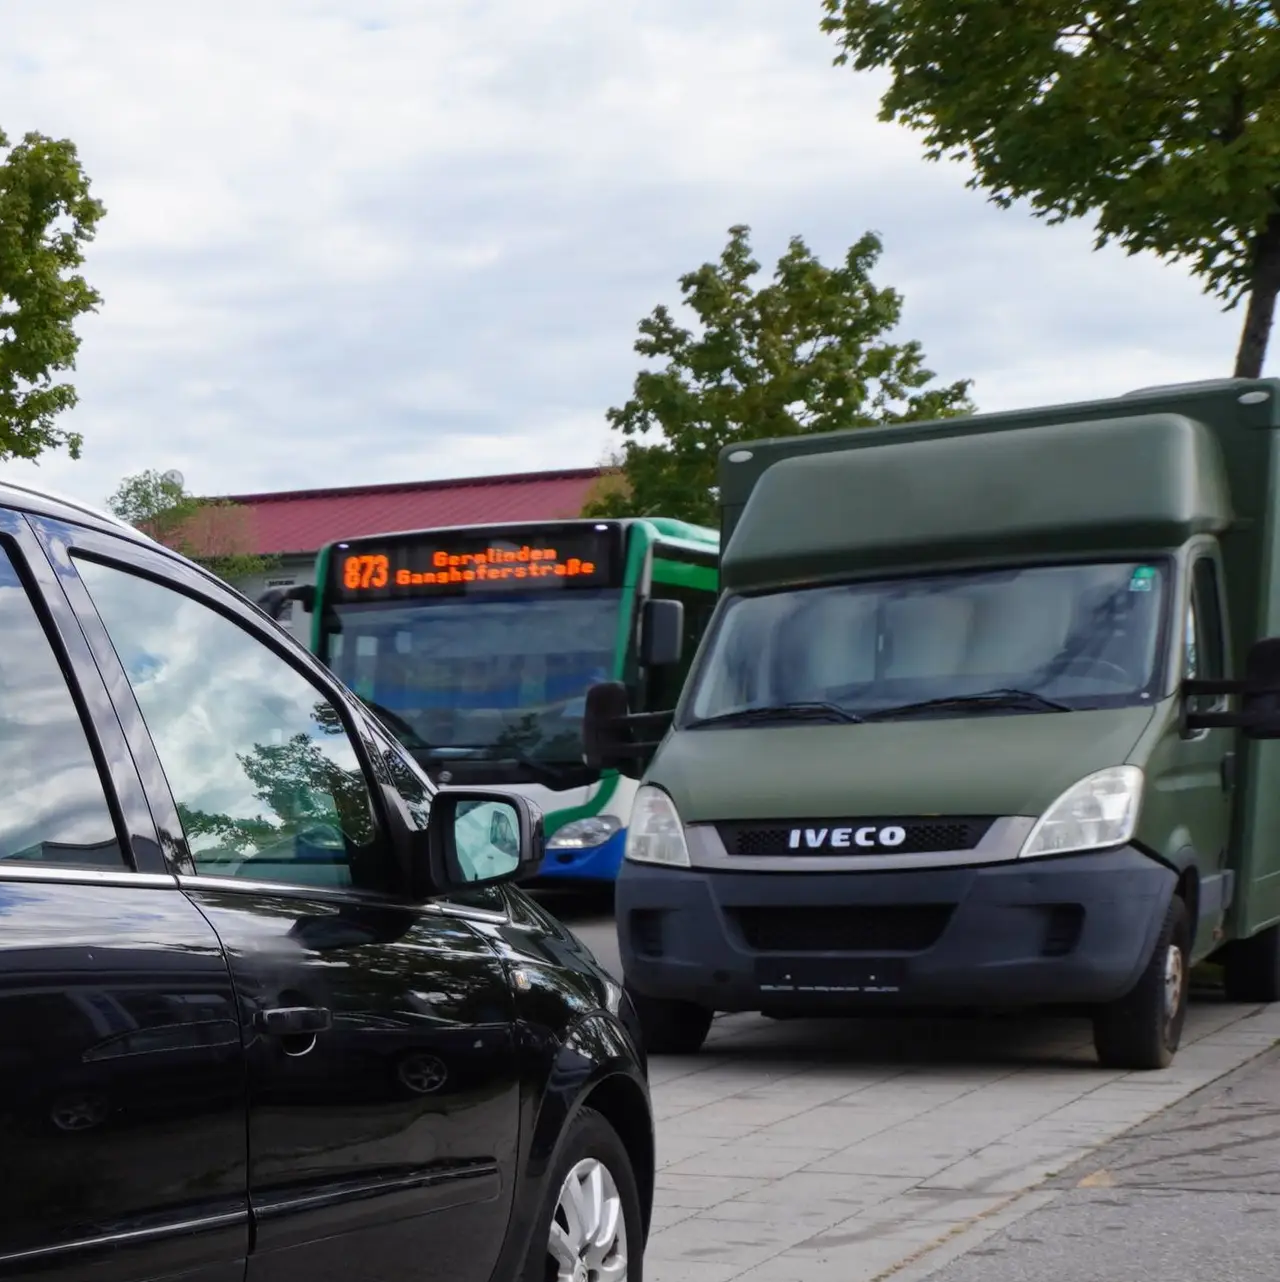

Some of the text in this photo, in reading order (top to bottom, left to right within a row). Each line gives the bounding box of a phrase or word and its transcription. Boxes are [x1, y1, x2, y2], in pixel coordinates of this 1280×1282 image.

[433, 546, 557, 567] Gernlinden
[344, 554, 388, 589] 873
[396, 558, 595, 585] Ganghoferstraße
[788, 826, 906, 848] IVECO
